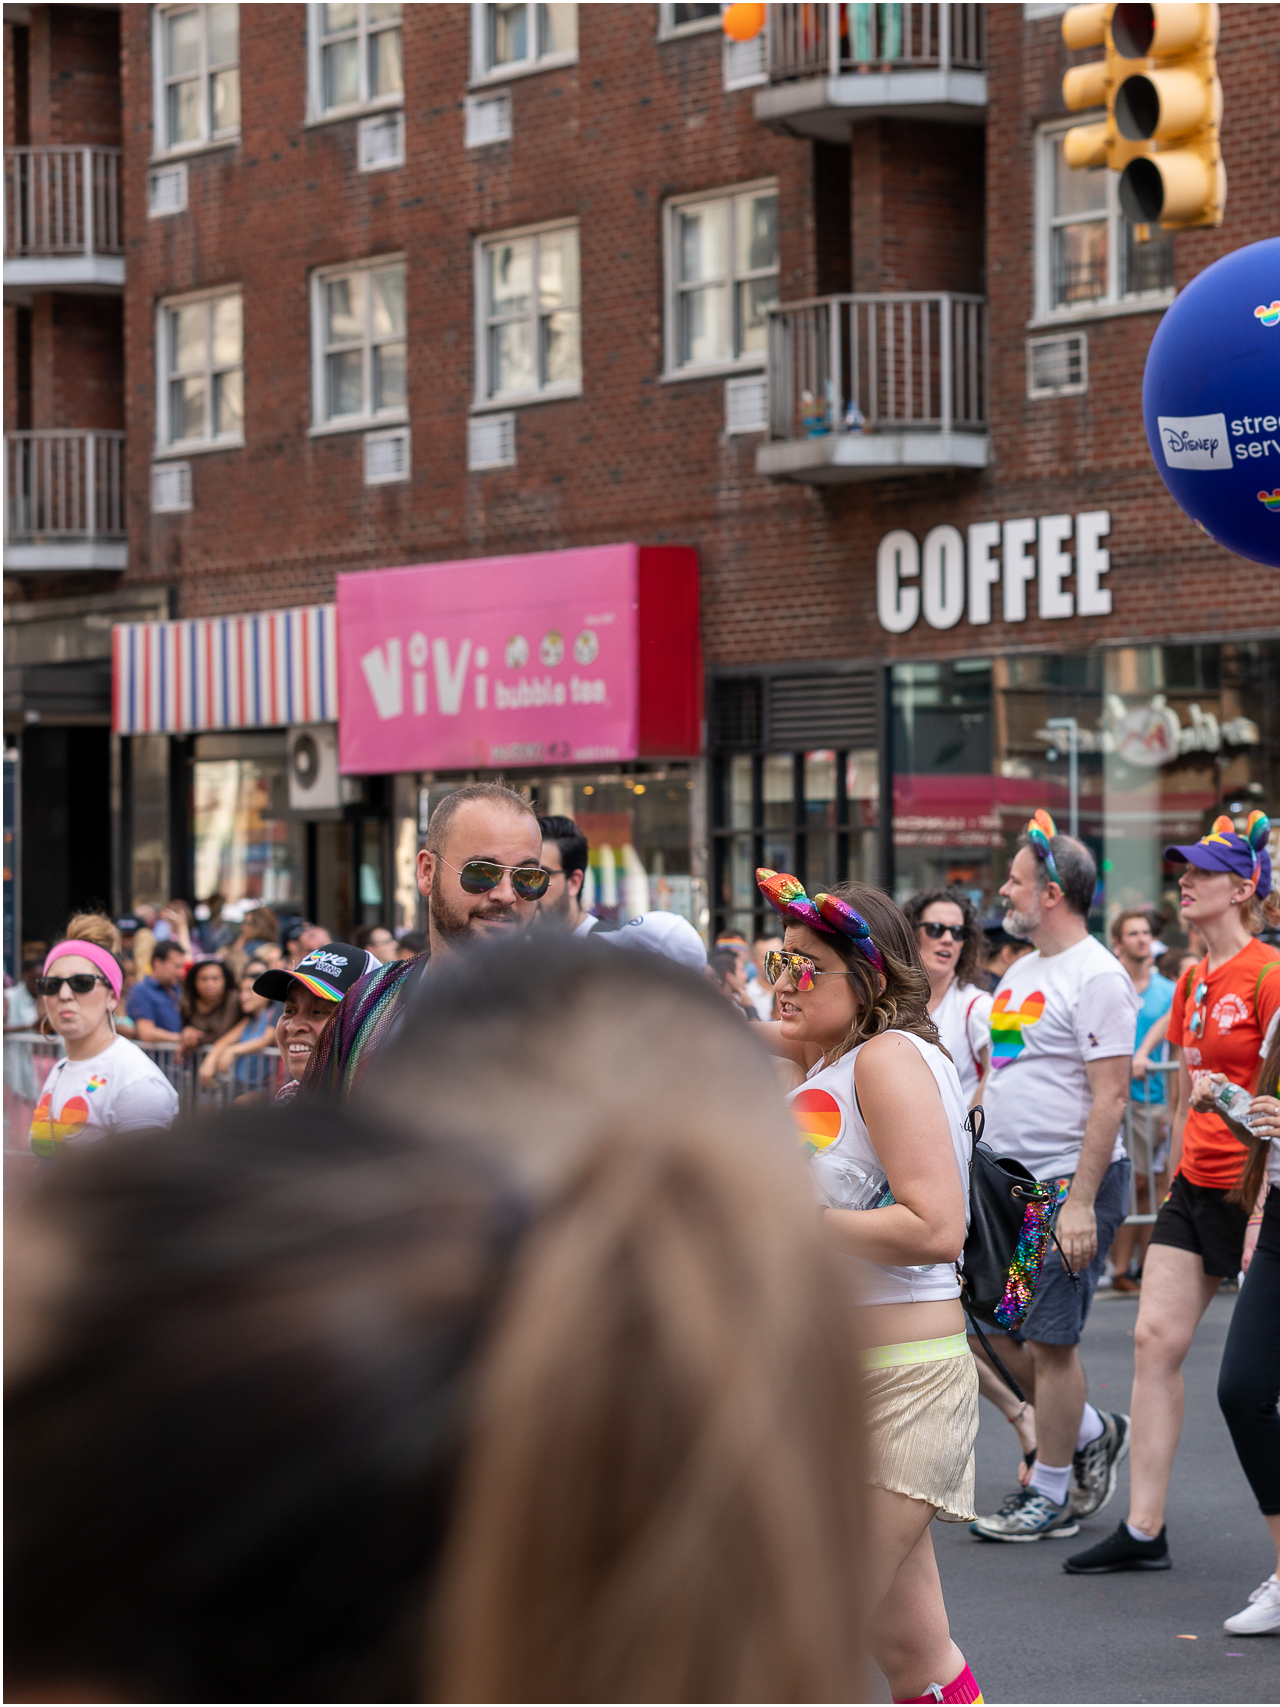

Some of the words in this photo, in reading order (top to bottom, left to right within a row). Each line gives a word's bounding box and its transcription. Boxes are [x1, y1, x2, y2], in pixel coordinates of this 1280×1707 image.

[876, 510, 1112, 633] COFFEE
[495, 678, 566, 711] bubble
[570, 675, 607, 704] tea
